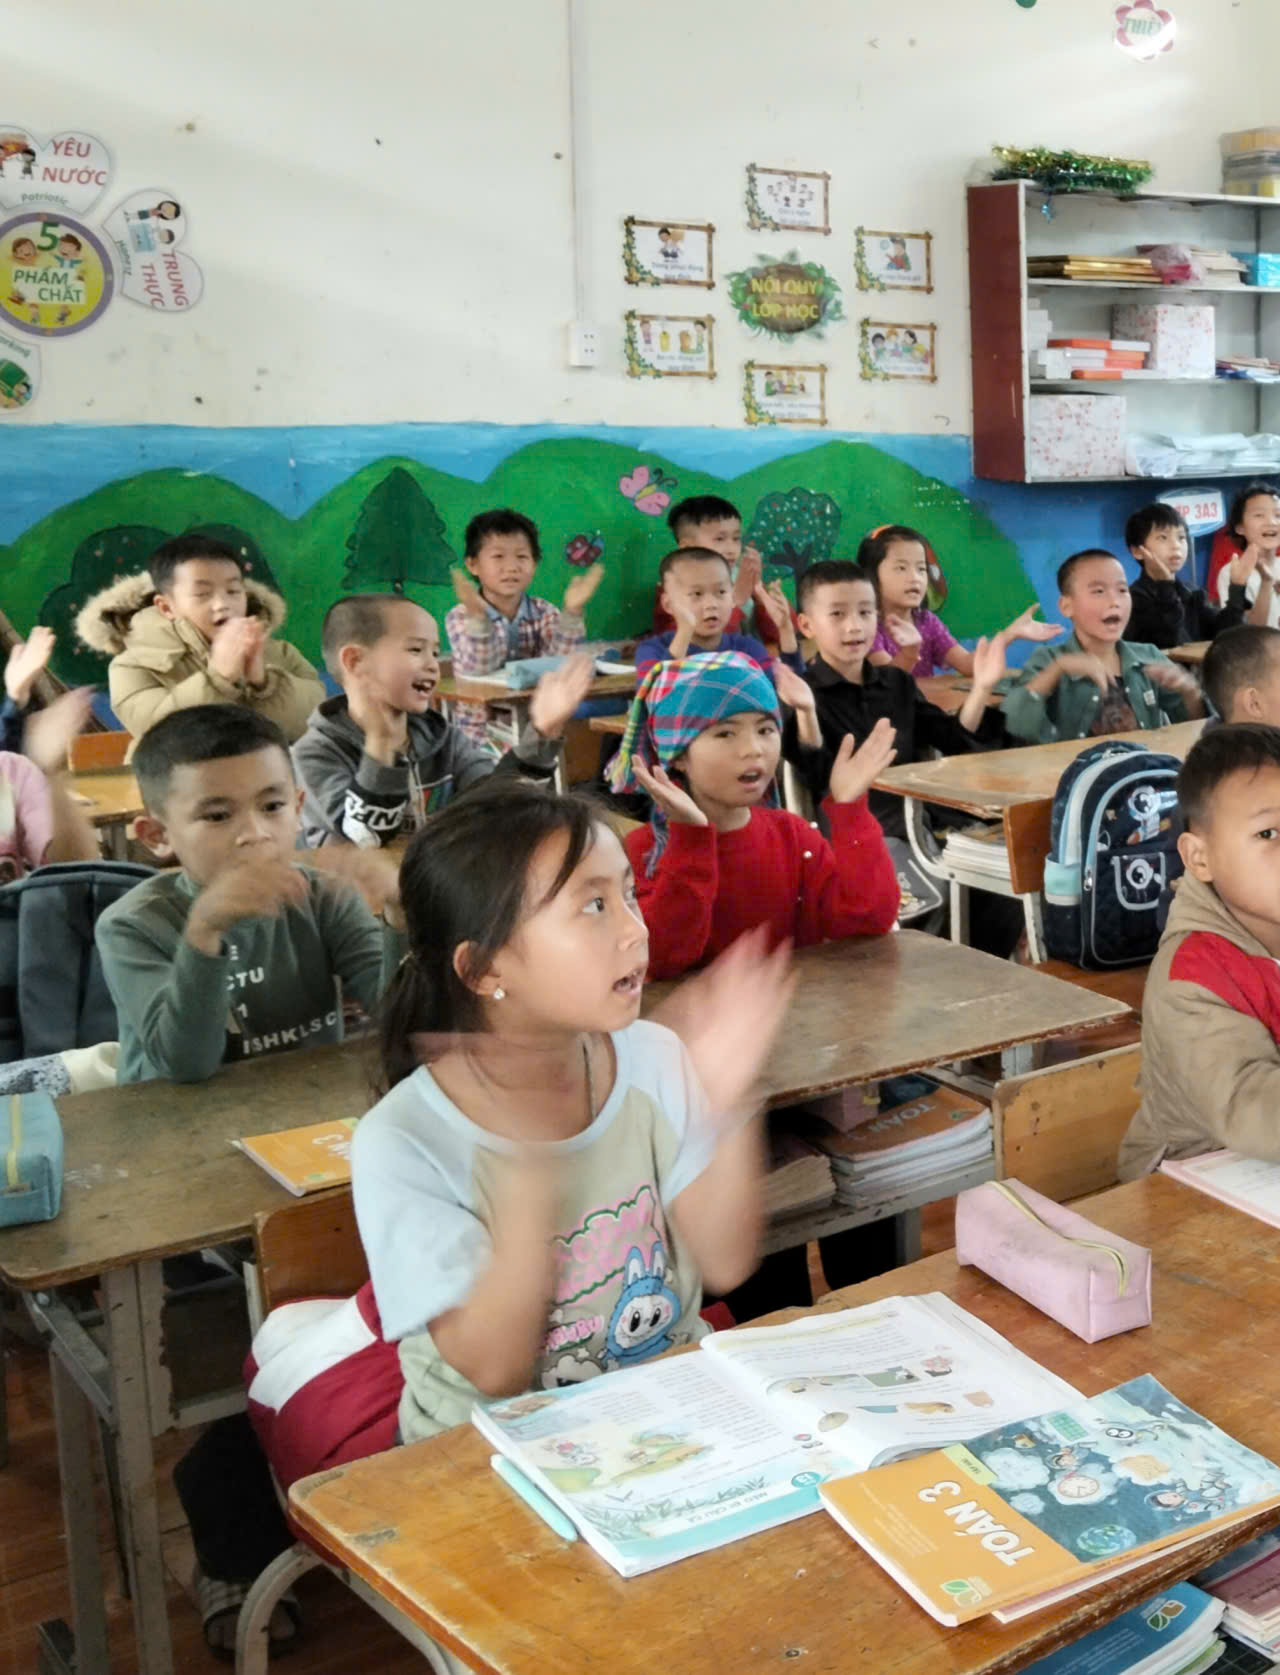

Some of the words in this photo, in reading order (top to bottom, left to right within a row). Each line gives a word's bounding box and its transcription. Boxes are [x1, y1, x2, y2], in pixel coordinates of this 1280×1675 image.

[51, 137, 91, 158] YÊU
[42, 165, 107, 186] NƯỚC
[37, 221, 60, 252] 5
[161, 249, 190, 307] TRUNG
[783, 278, 817, 296] QUY
[785, 303, 819, 321] HỌC
[1194, 502, 1218, 520] 3A3
[917, 1480, 961, 1503] 3
[943, 1500, 1036, 1567] TOÁN
